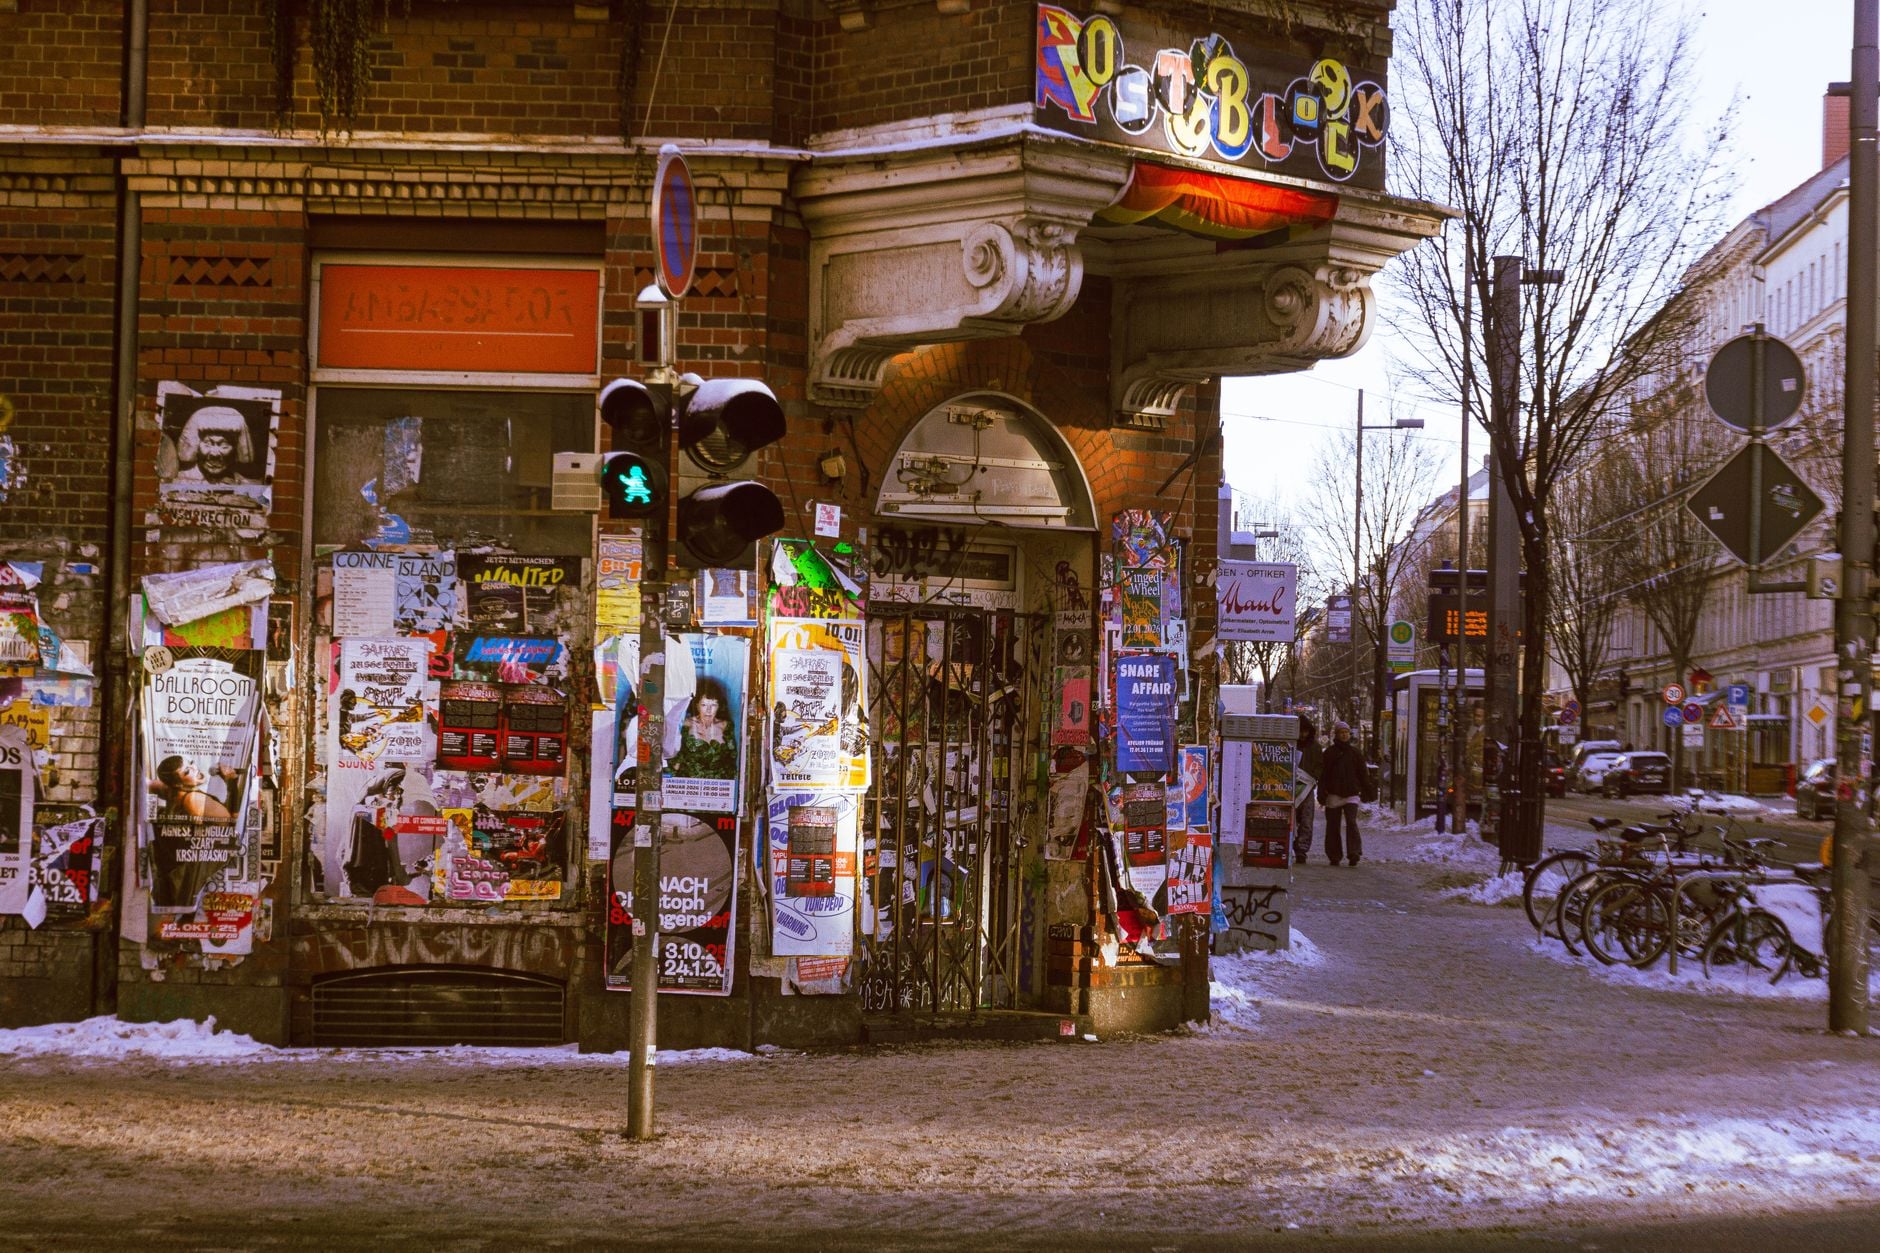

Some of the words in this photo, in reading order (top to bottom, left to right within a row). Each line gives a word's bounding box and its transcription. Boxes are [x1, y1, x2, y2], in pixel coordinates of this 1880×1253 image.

[336, 552, 394, 568] CONNE
[398, 561, 454, 577] ISLAND
[1247, 569, 1285, 578] OPTIKER
[1123, 570, 1160, 588] Winged
[1130, 583, 1160, 596] Wheel
[1221, 579, 1285, 615] Maul
[1120, 664, 1160, 678] SNARE
[155, 673, 250, 697] BALLROOM
[1131, 682, 1171, 695] AFFAIR
[1667, 689, 1681, 699] 30
[1732, 687, 1744, 703] P
[167, 697, 236, 716] BOHEME
[1261, 753, 1292, 763] Wheel
[338, 761, 375, 771] SUUNS
[1252, 783, 1293, 792] 12.01.2026
[190, 837, 216, 850] SZARY
[176, 849, 198, 862] KRSN
[199, 849, 229, 862] BRASKO
[182, 924, 210, 932] OKT
